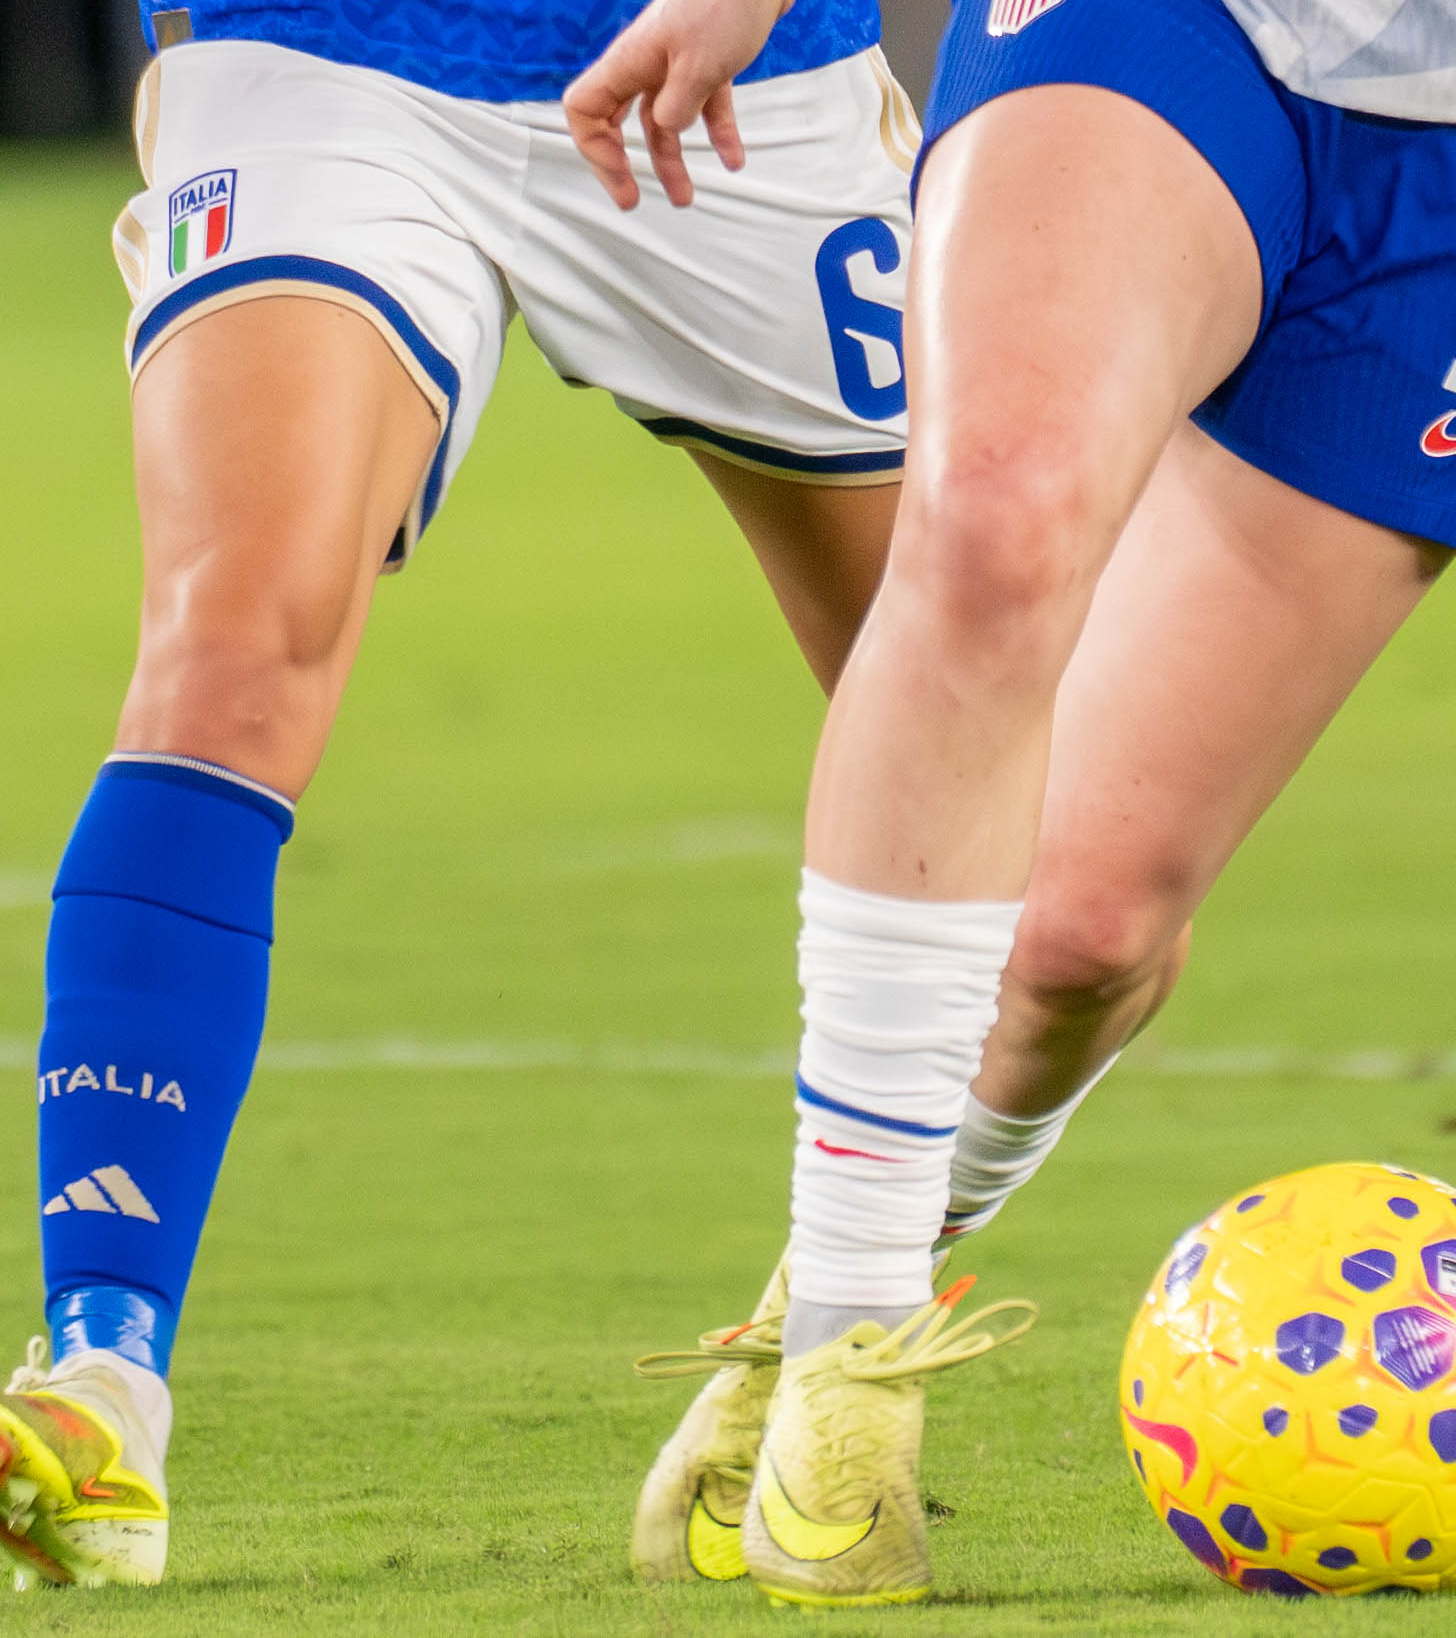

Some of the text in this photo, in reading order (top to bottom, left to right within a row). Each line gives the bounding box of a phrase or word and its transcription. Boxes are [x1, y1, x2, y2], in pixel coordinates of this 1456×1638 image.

[174, 177, 227, 216] ITALIA
[815, 216, 908, 422] 6
[38, 1063, 186, 1112] ITALIA
